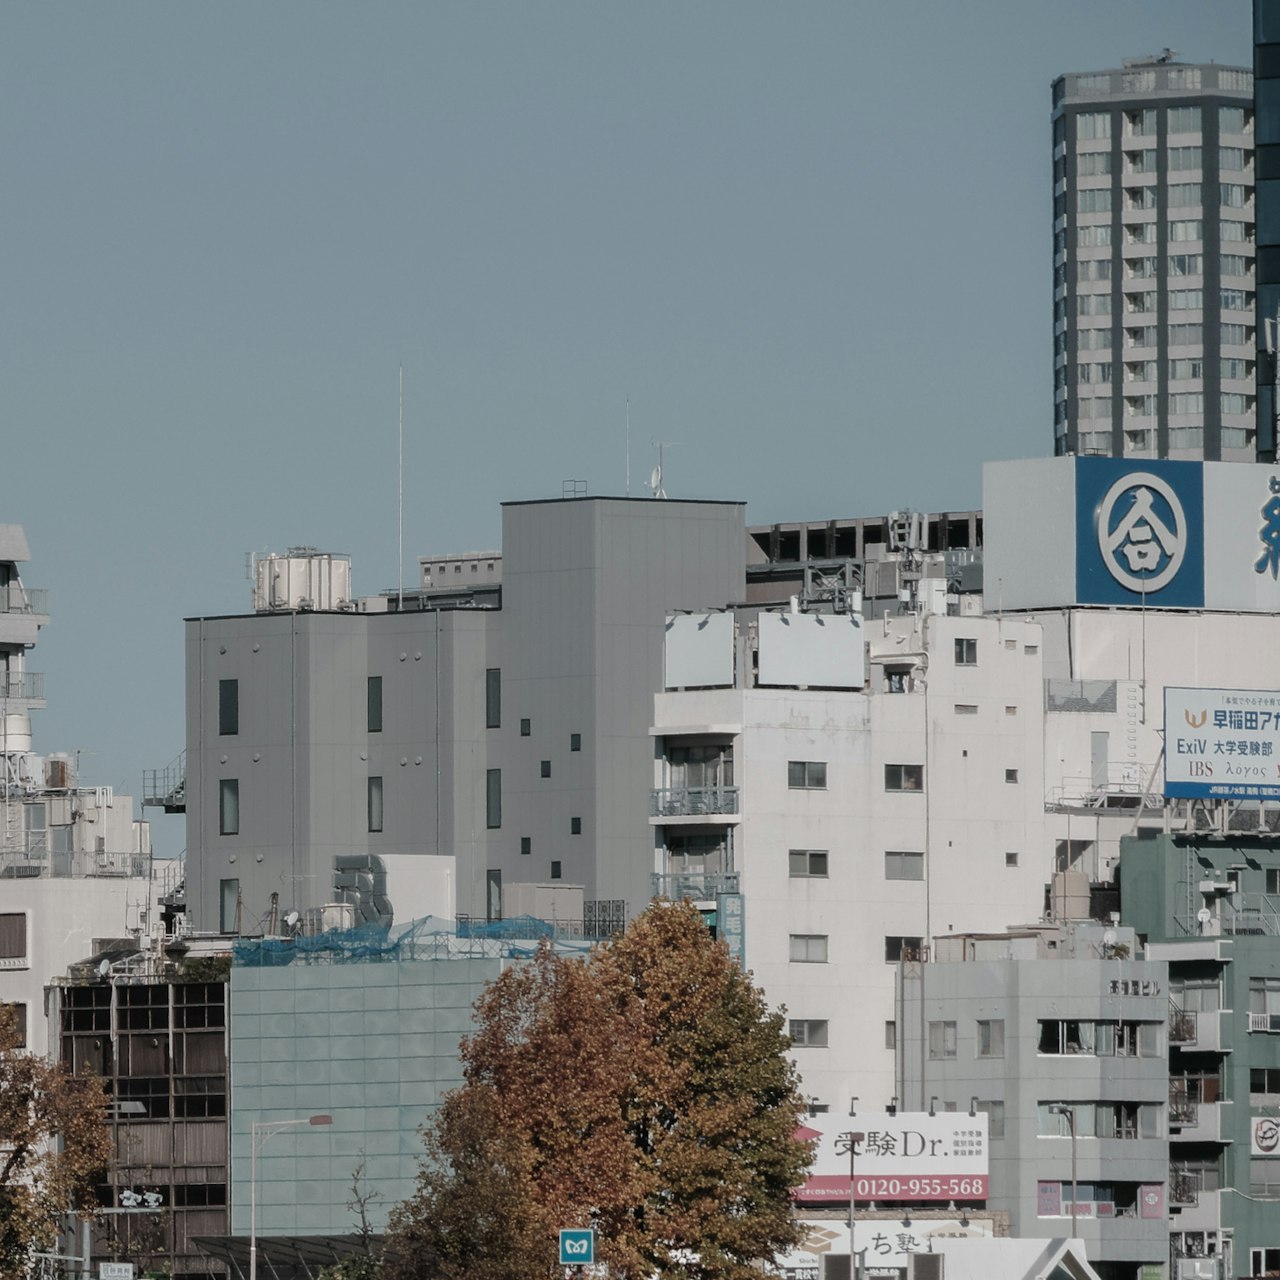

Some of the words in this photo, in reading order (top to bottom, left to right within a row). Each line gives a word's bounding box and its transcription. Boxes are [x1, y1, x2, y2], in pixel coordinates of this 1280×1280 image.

[1177, 738, 1207, 754] ExiV
[1214, 740, 1273, 756] 大学受験部
[1189, 761, 1213, 777] IBS
[857, 1178, 983, 1196] 0120-955-568
